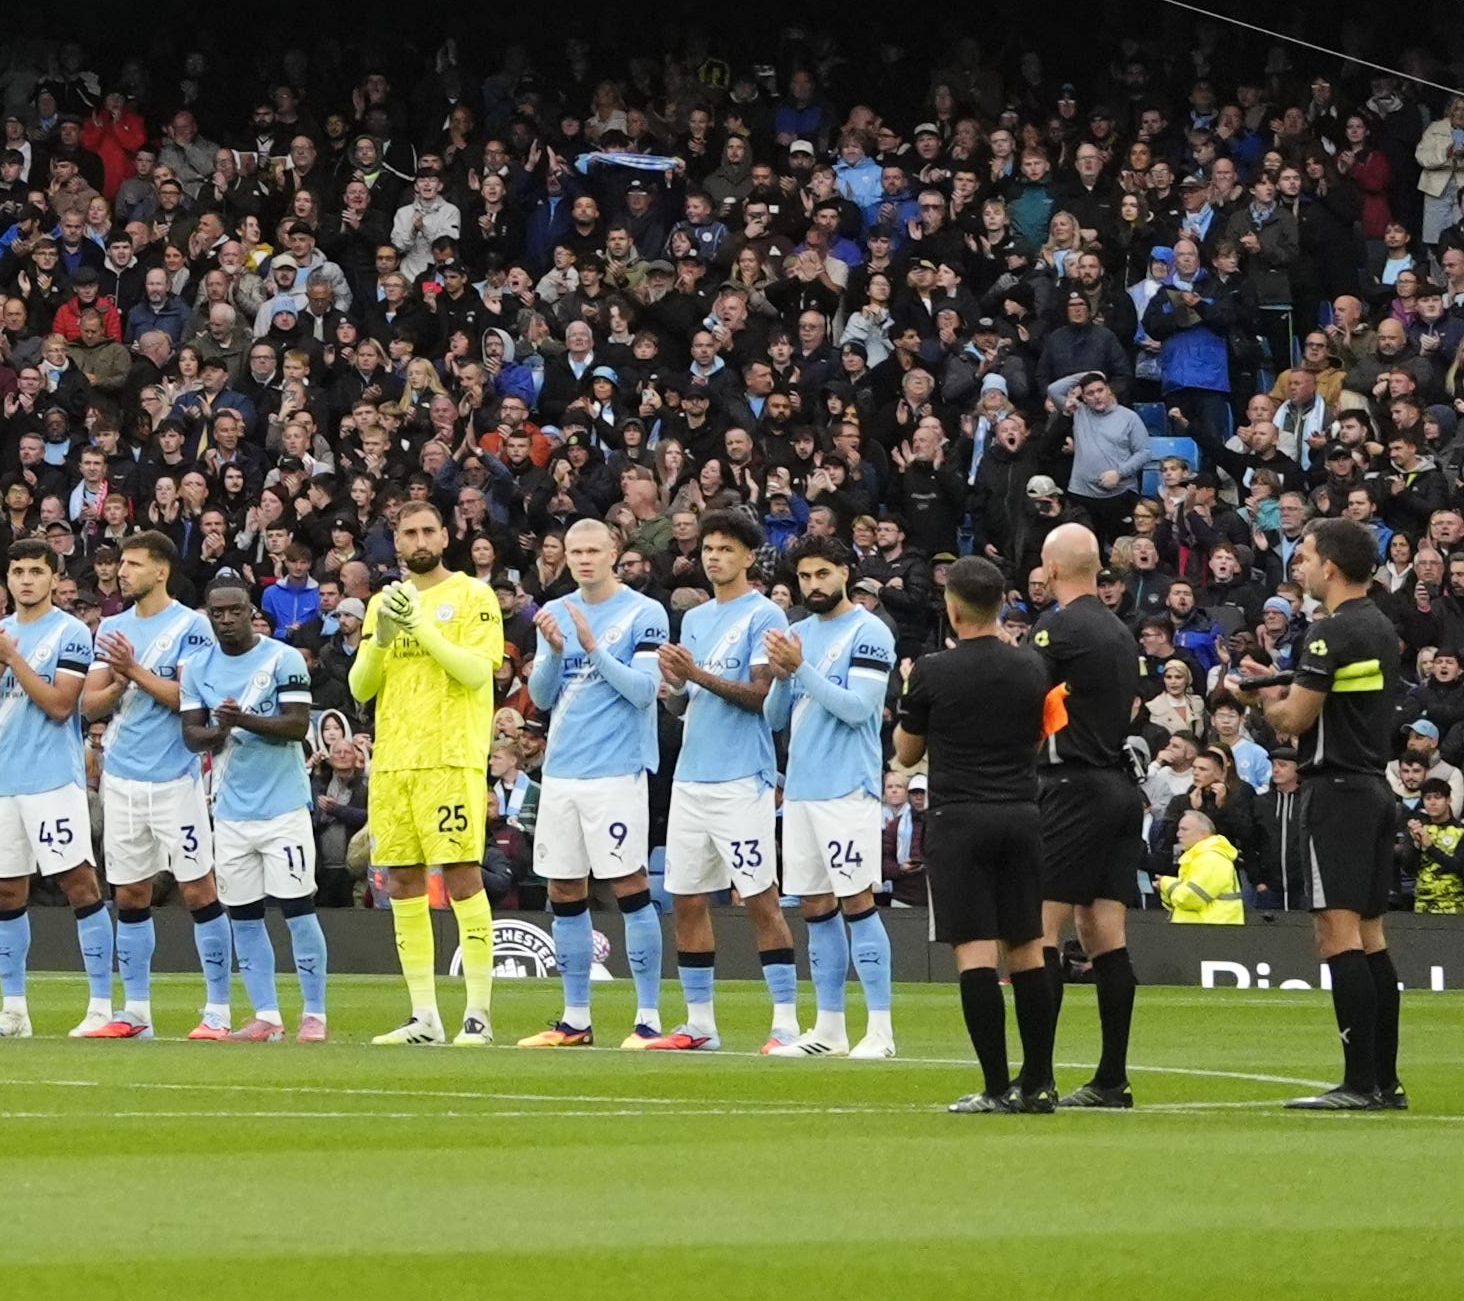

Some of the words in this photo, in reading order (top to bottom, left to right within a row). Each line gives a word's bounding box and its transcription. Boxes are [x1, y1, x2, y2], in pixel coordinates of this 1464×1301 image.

[39, 818, 74, 845] 45
[437, 804, 468, 833] 25
[180, 825, 199, 853] 3
[609, 822, 628, 847] 9
[283, 845, 306, 872] 11
[730, 839, 762, 869] 33
[828, 840, 863, 869] 24
[493, 929, 558, 969] CHESTER
